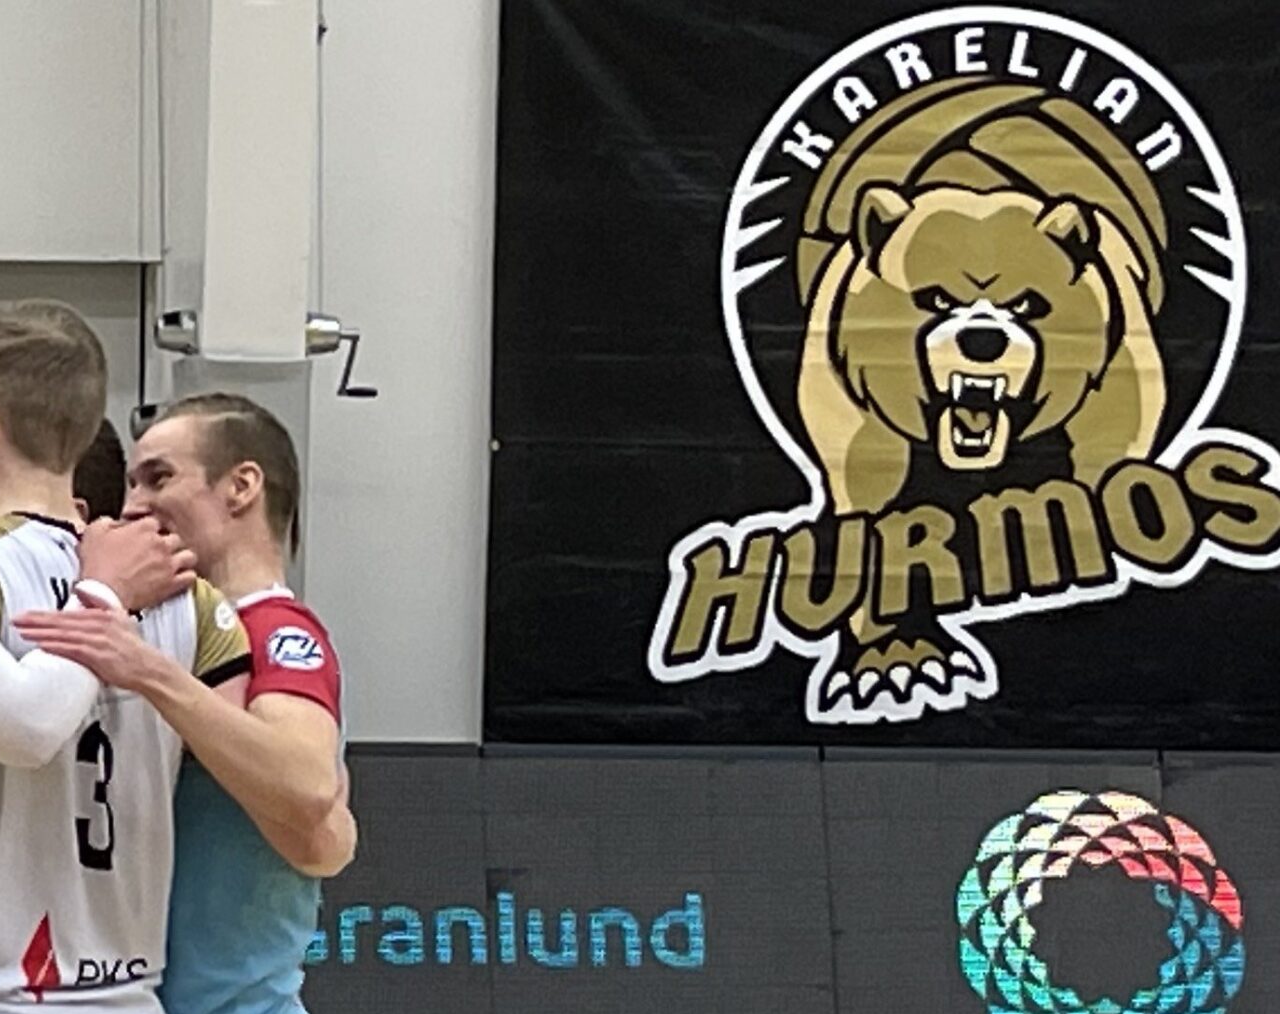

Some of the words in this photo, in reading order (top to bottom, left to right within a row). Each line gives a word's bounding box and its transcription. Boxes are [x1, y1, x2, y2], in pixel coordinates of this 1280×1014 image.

[783, 27, 1183, 170] KARELIAN
[671, 447, 1280, 656] HURMOS
[75, 720, 115, 871] 3
